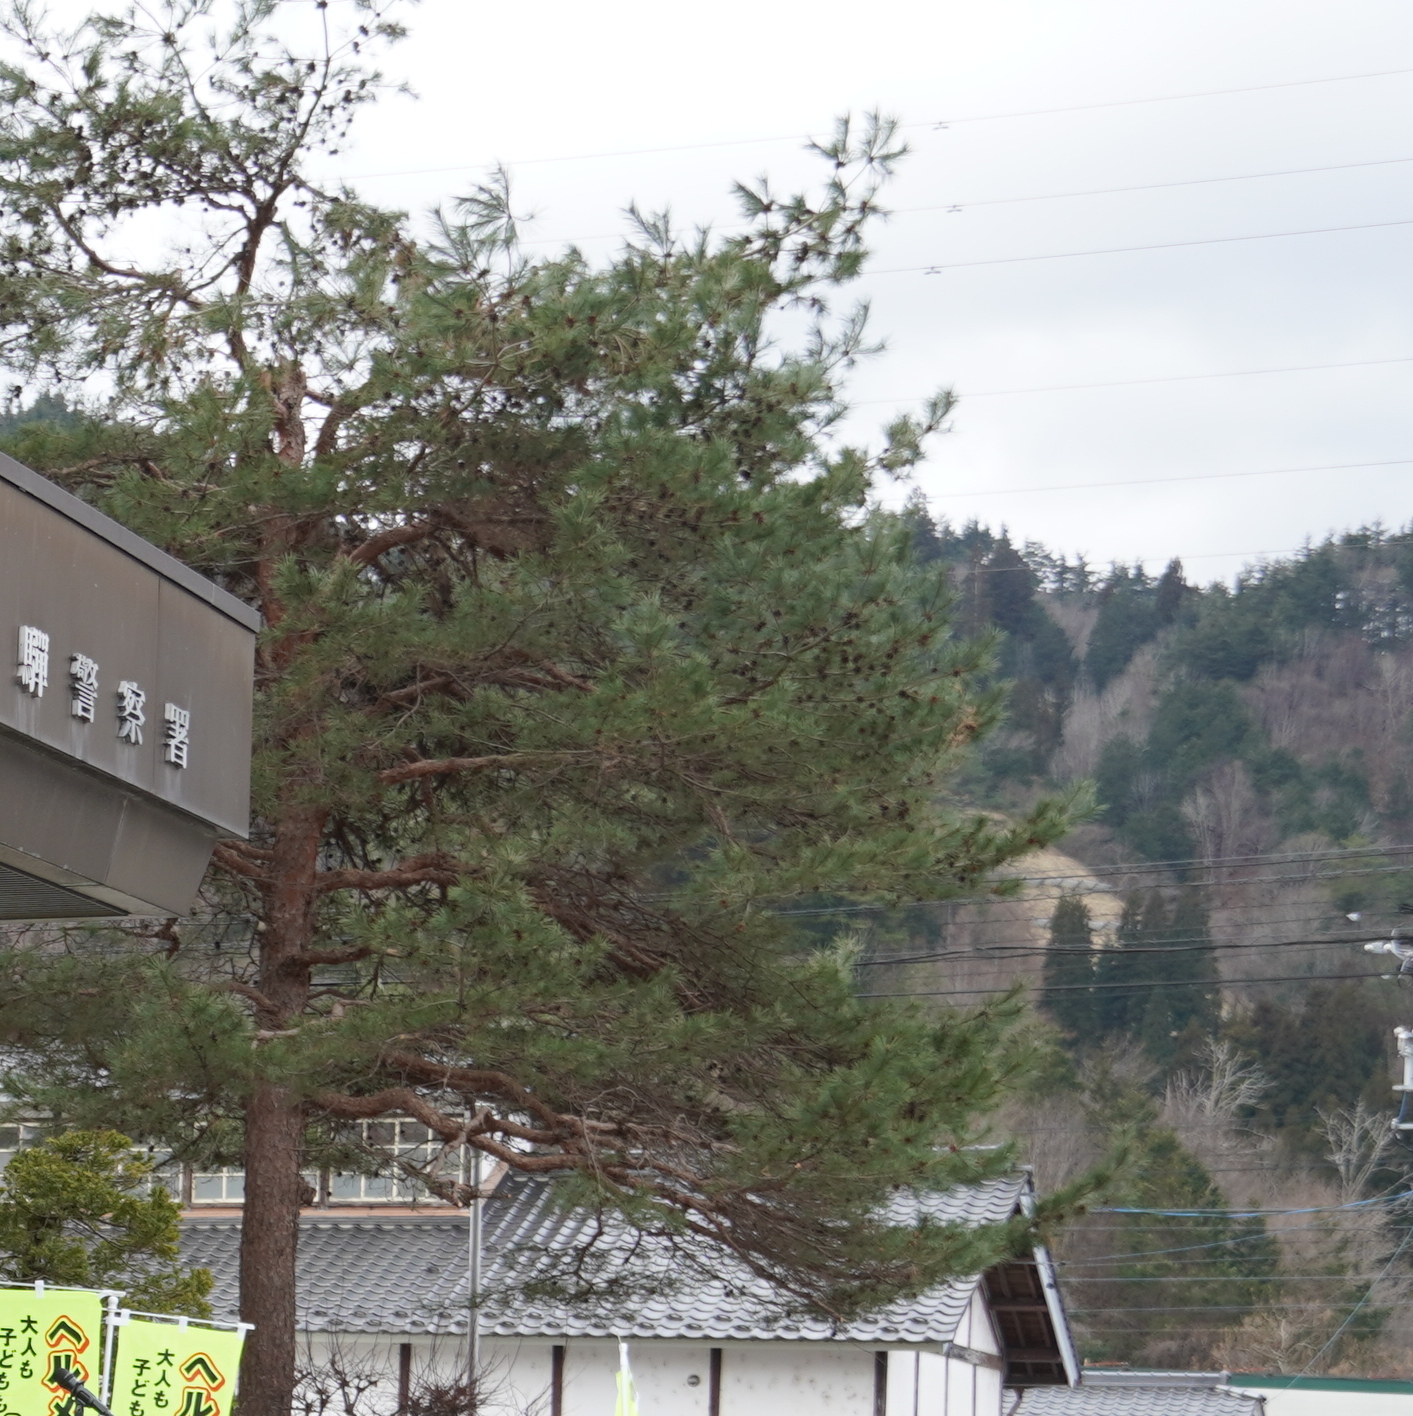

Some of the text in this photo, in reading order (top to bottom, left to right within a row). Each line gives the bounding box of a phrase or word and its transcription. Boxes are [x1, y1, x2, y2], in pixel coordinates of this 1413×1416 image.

[19, 1315, 38, 1379] 大人も
[154, 1349, 175, 1408] 大人も
